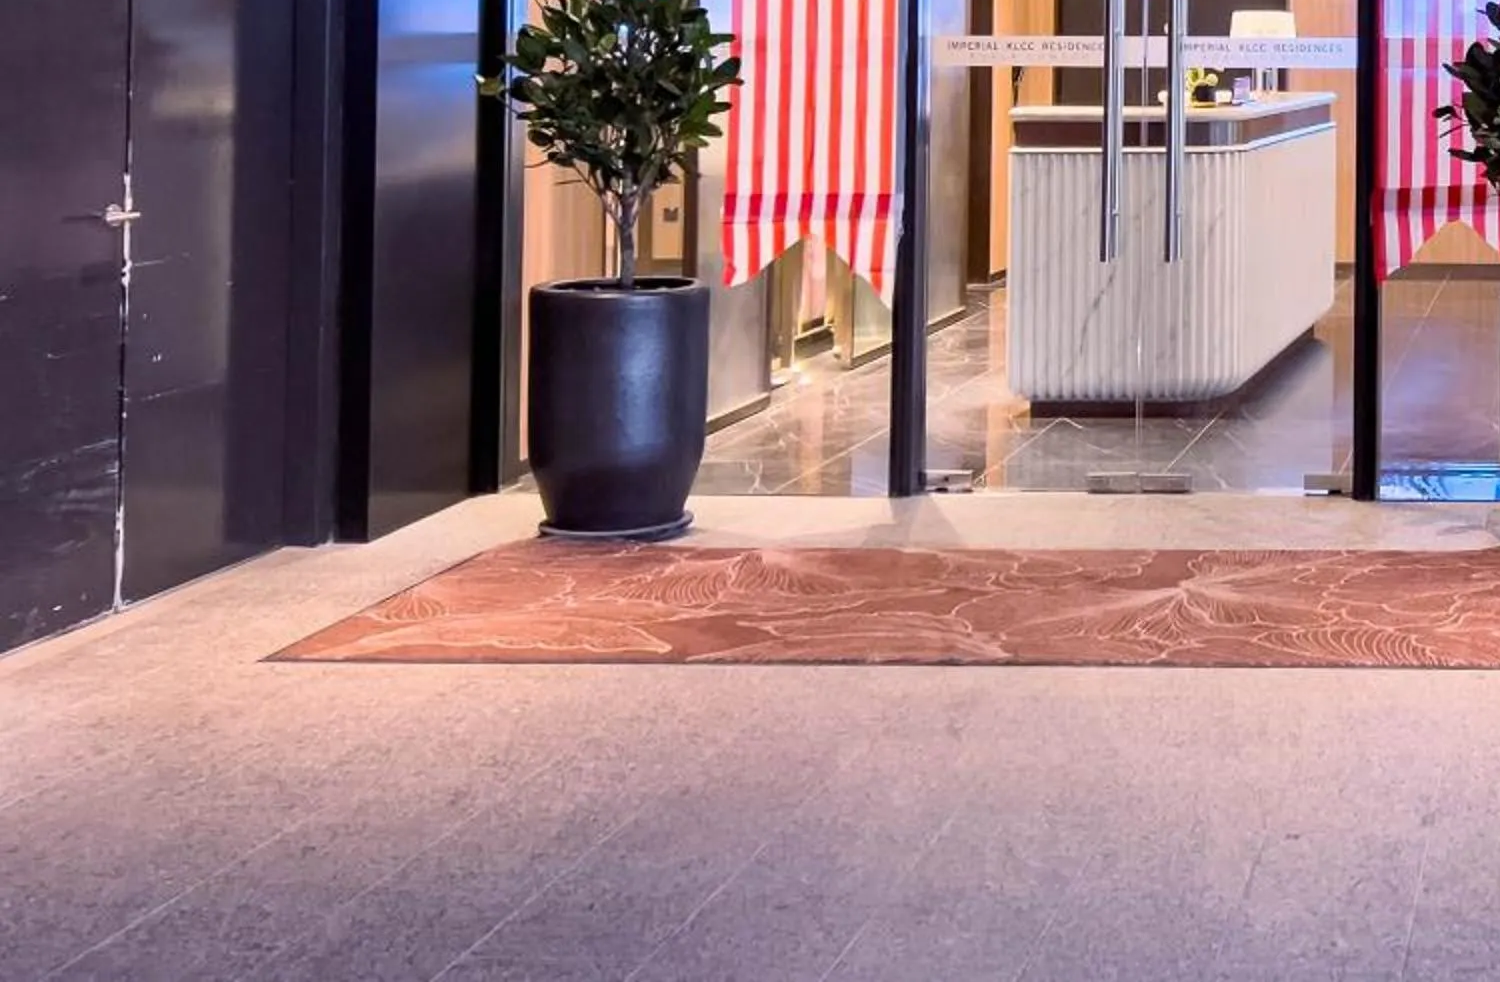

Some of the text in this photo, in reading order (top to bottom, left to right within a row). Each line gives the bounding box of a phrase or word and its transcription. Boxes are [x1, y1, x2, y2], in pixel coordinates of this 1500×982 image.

[947, 41, 1105, 52] IMPERIAL KLCC RESIDENCE
[1273, 43, 1343, 54] RESIDENCES
